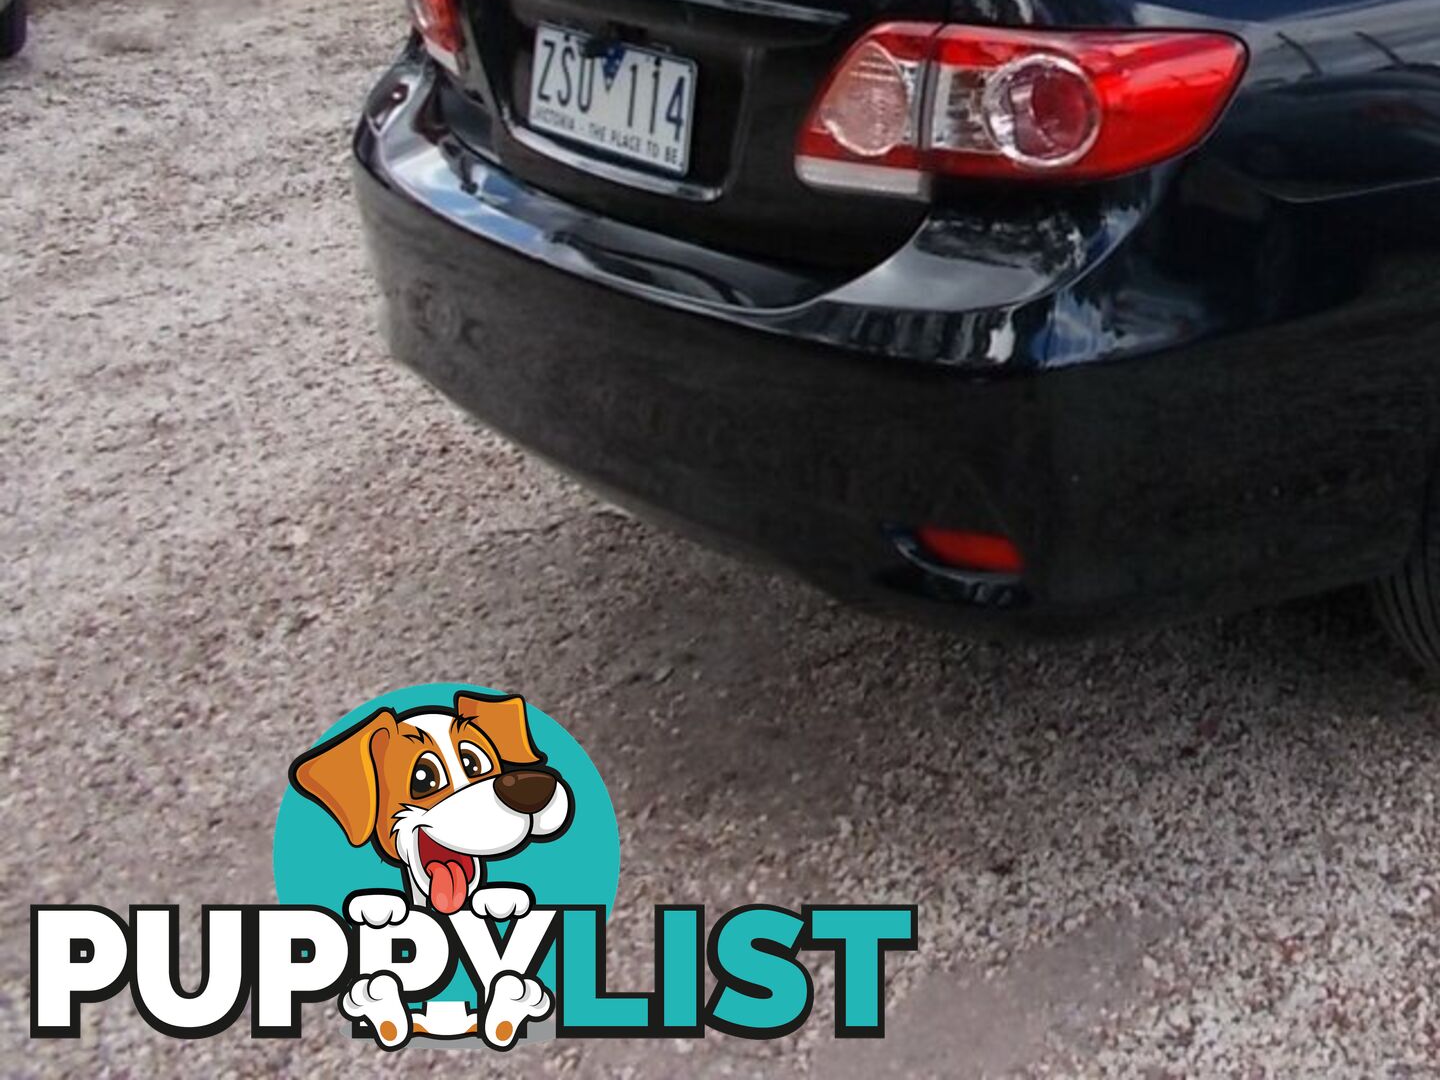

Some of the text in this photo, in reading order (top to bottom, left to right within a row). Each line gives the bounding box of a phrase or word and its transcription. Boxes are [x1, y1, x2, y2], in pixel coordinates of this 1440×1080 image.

[627, 63, 685, 142] 114
[588, 122, 606, 142] THE
[611, 128, 641, 152] PLACE
[647, 139, 660, 157] TO
[664, 145, 679, 165] BE
